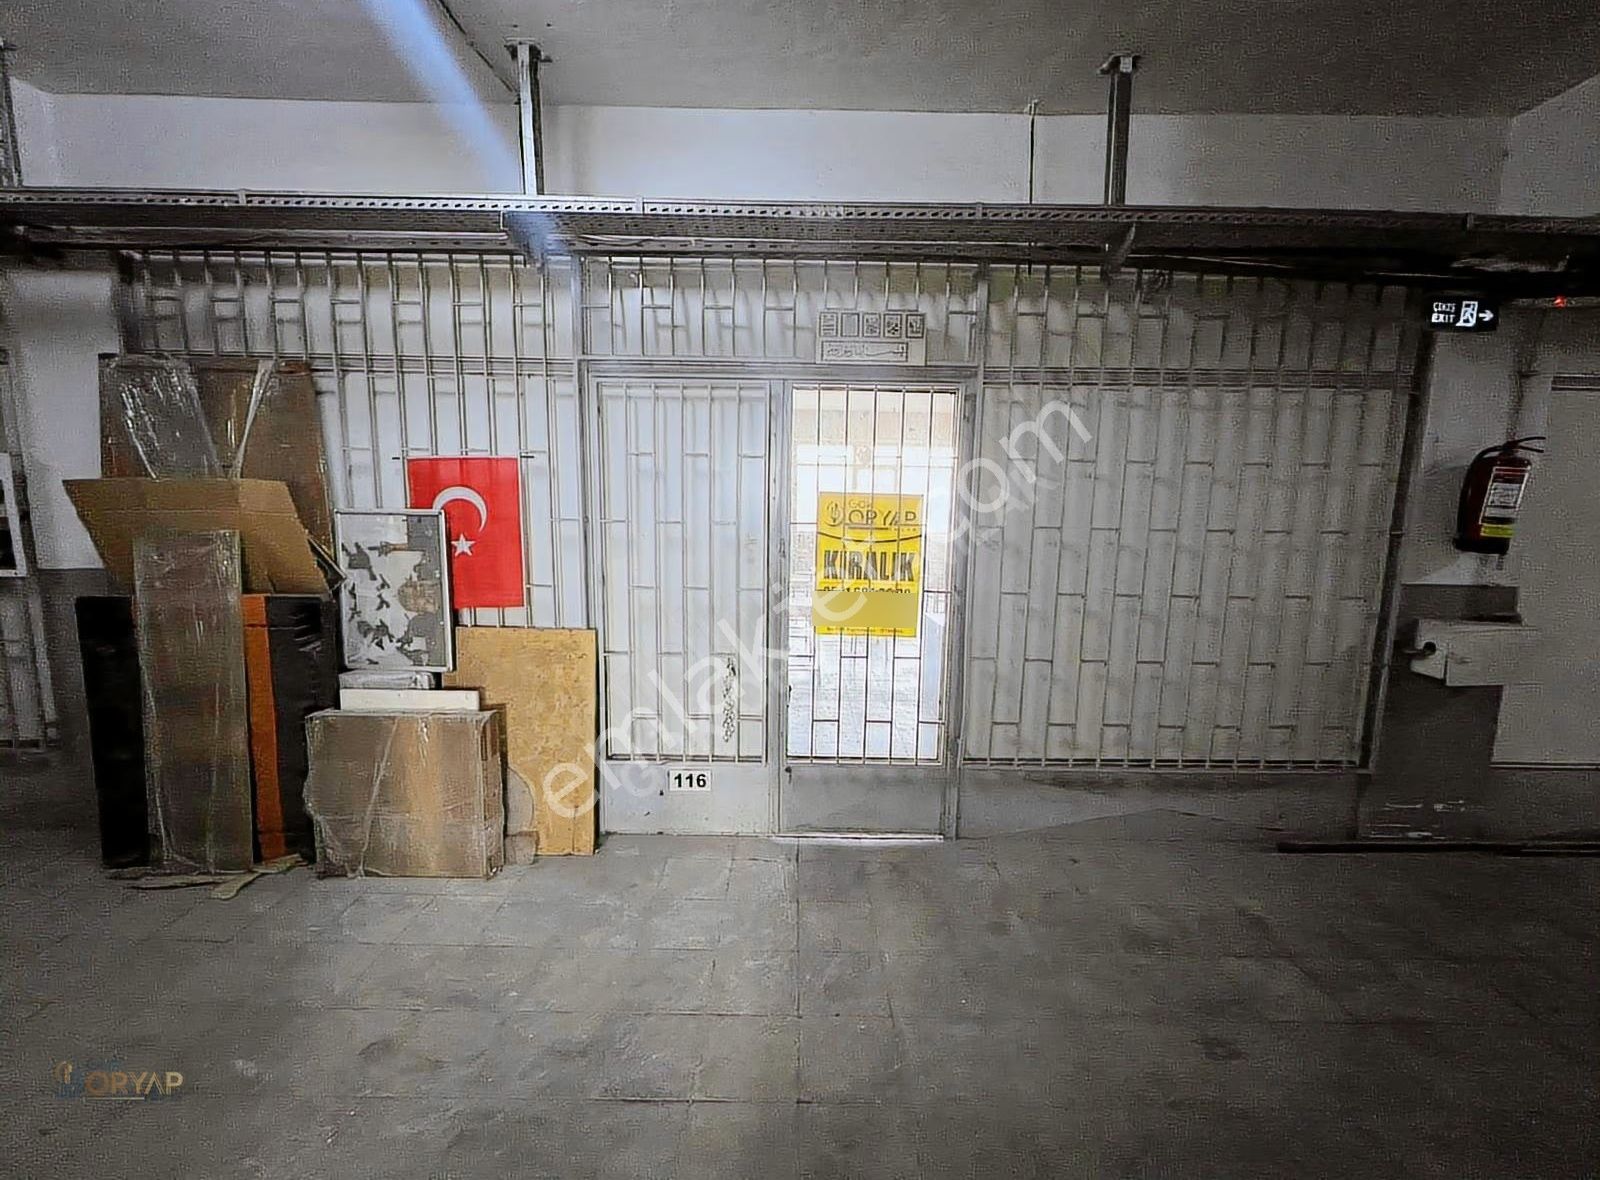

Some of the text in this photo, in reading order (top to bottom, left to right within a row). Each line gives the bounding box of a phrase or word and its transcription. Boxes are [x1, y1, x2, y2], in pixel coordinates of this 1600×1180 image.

[1432, 313, 1456, 323] EXIT
[824, 550, 915, 582] KIRALIK
[674, 773, 707, 788] 116
